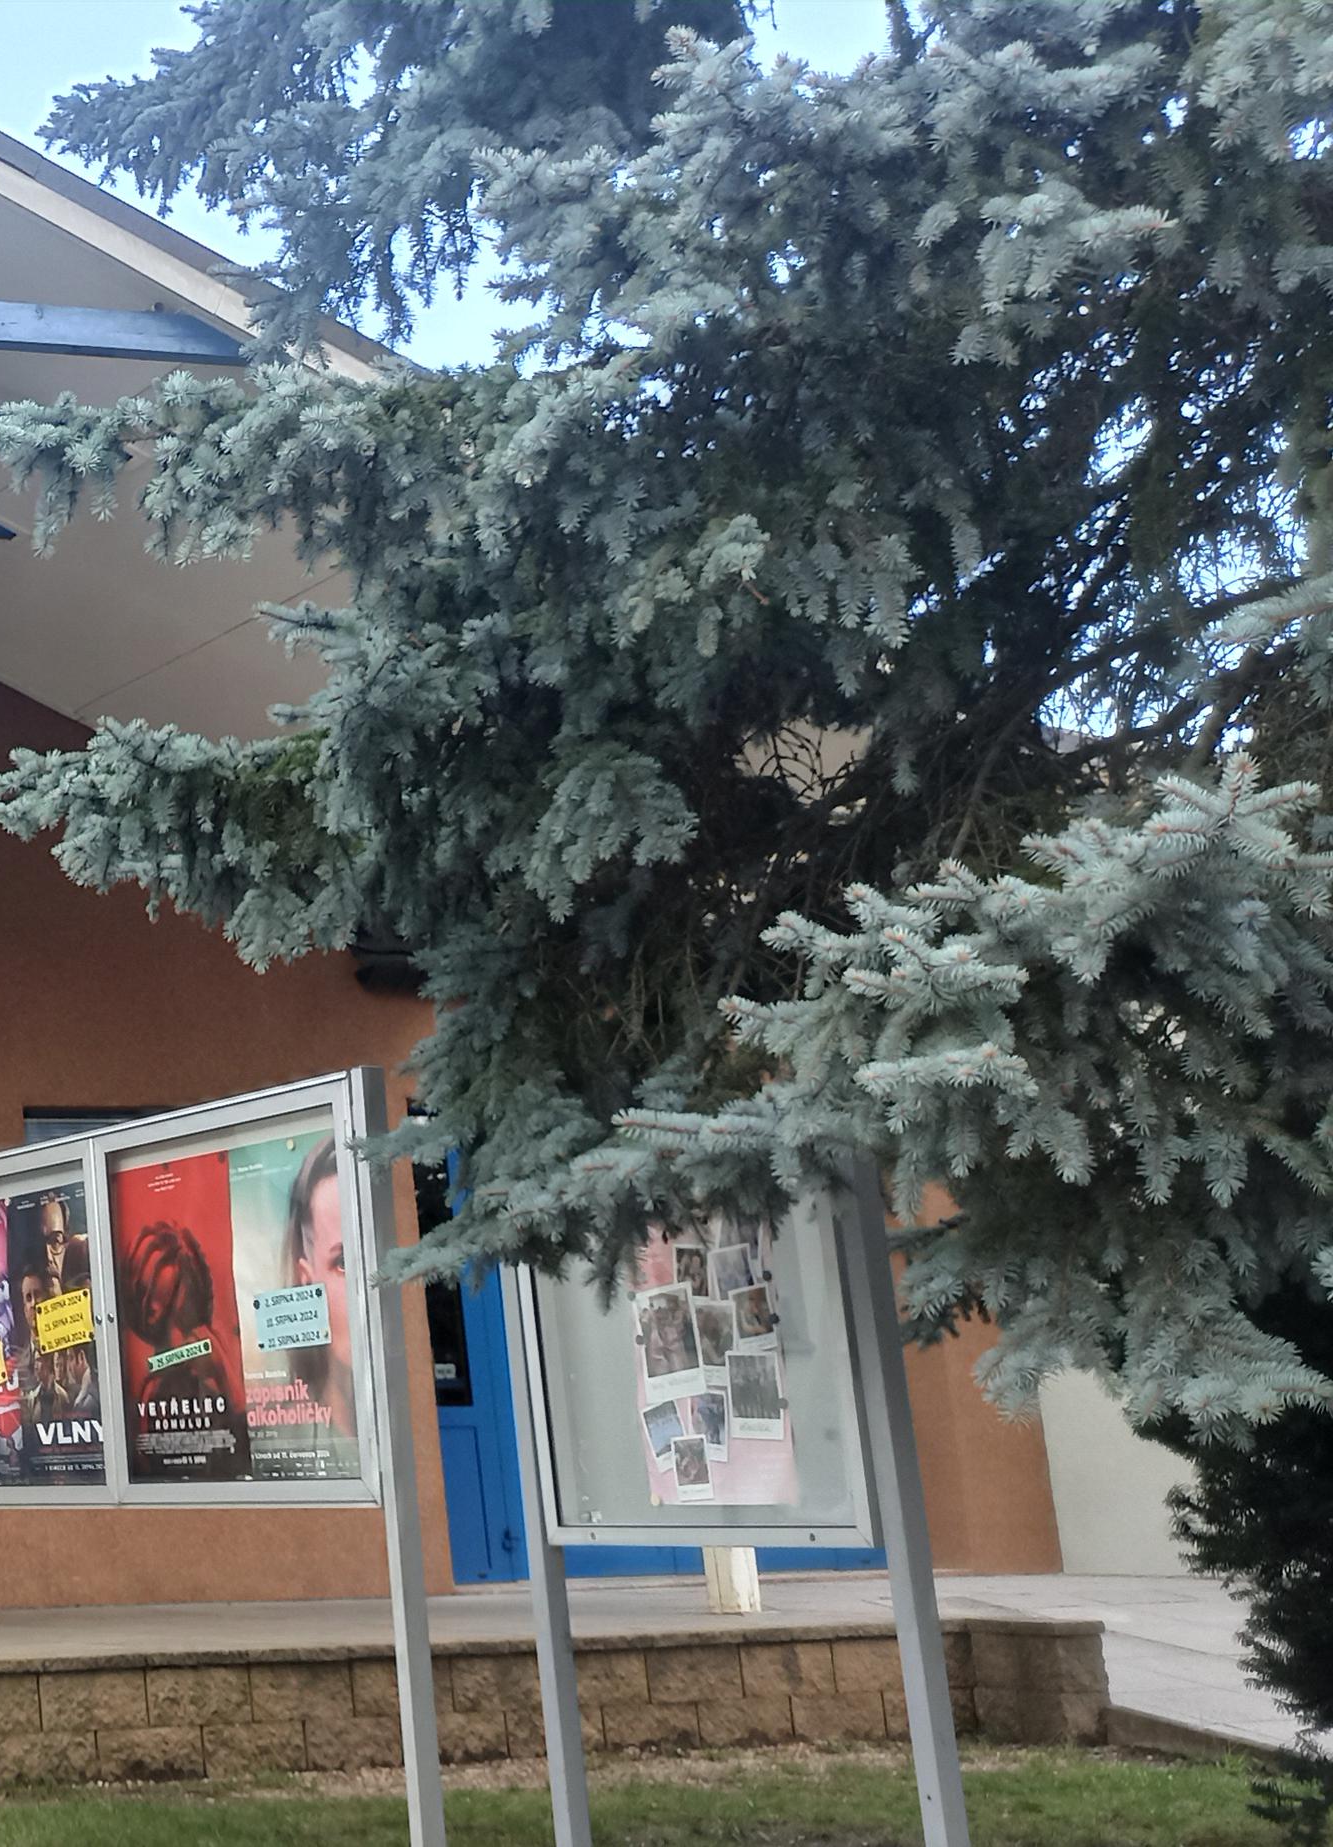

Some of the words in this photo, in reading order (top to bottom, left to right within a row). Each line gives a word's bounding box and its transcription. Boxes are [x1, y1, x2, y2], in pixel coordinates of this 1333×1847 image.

[299, 1309, 319, 1322] 2024
[301, 1330, 321, 1343] 2024
[247, 1401, 332, 1429] alkoholičky
[155, 1417, 211, 1431] ROMULUS
[36, 1419, 104, 1446] VLNY
